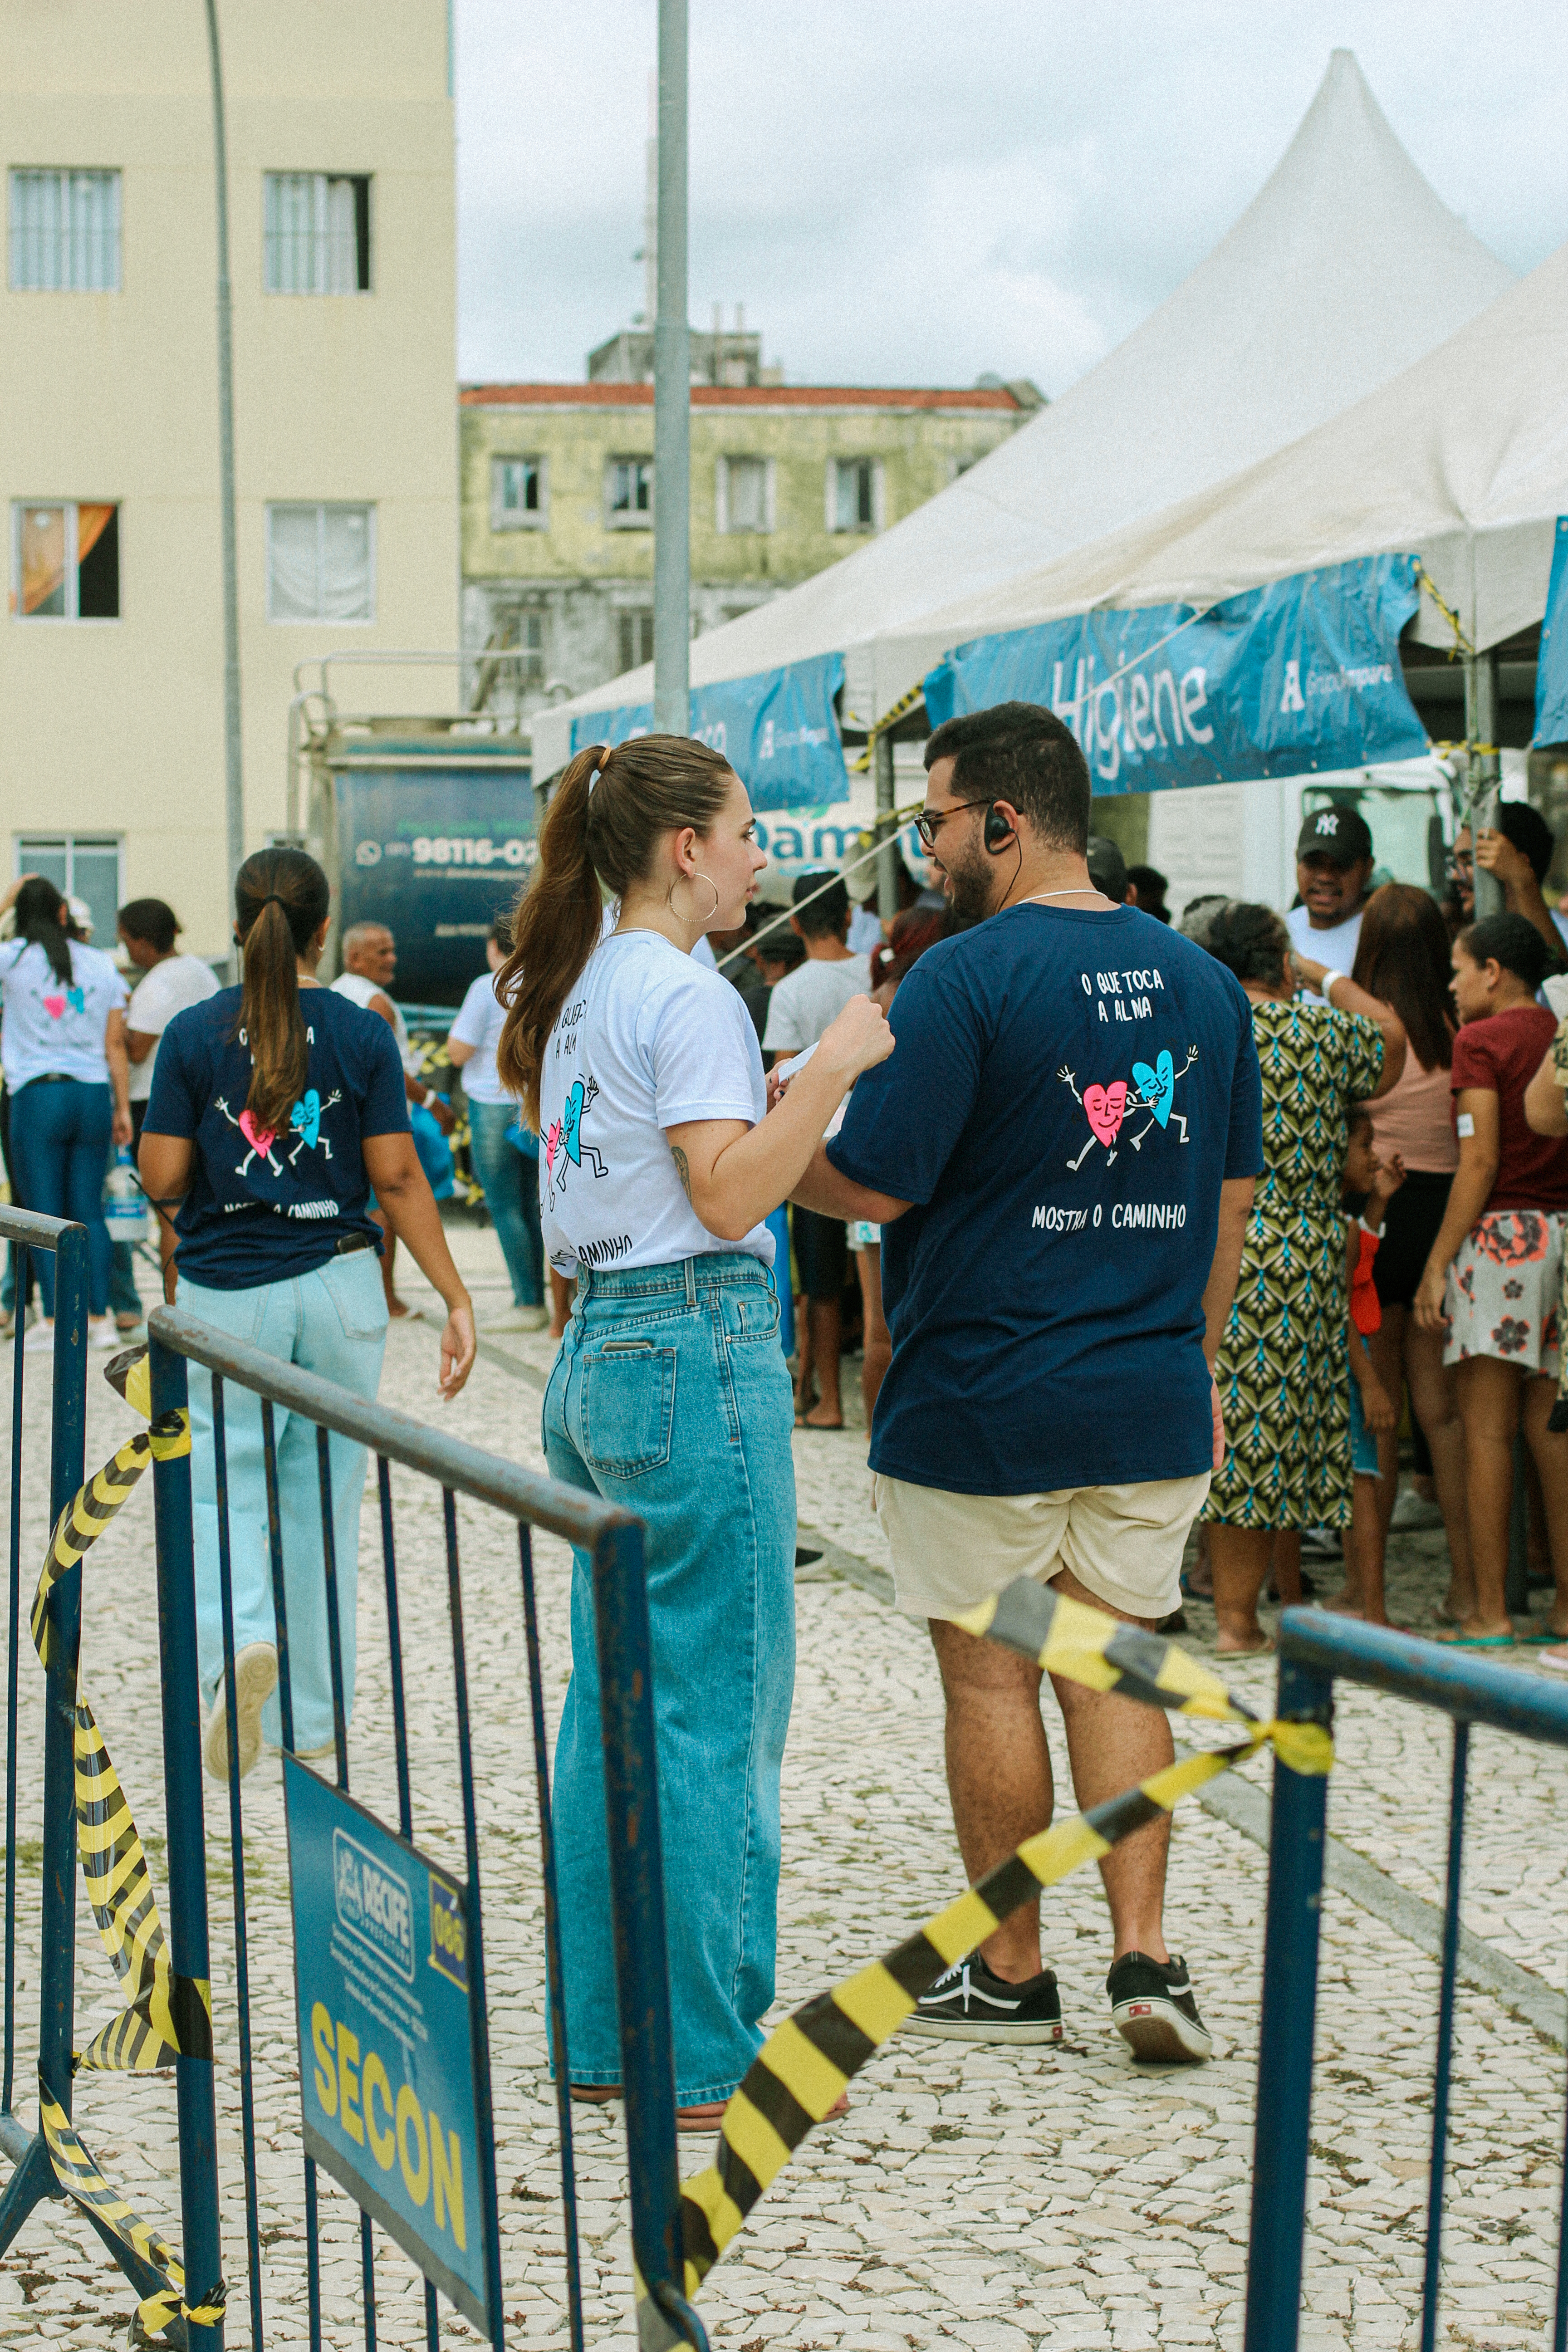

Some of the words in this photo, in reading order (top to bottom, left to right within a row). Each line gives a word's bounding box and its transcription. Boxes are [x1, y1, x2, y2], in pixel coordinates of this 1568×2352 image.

[1051, 650, 1215, 781] Higiene
[1081, 973, 1092, 996] O
[1096, 971, 1123, 995] QUE
[1121, 968, 1165, 993] TOCA
[1098, 1000, 1109, 1023] A
[1114, 996, 1152, 1022] ALMA
[556, 1038, 560, 1059] A
[1032, 1205, 1088, 1231] MOSTRA
[1093, 1204, 1102, 1228] O
[1112, 1203, 1186, 1230] CAMINHO
[363, 1862, 410, 1948] RECIFE
[311, 2001, 466, 2252] SECON
